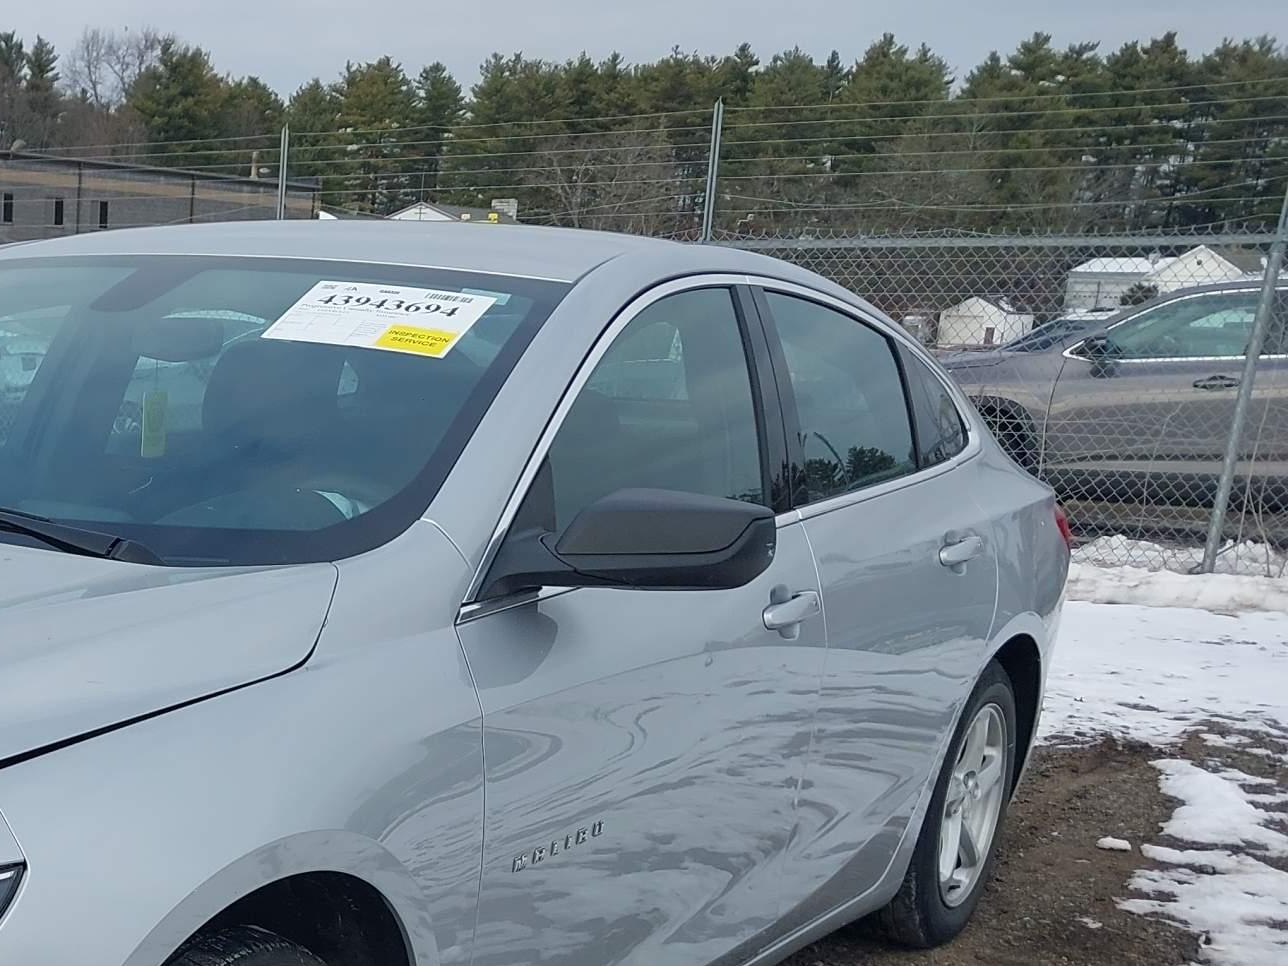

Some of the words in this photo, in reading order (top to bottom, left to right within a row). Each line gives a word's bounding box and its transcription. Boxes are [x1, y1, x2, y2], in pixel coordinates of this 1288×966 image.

[318, 294, 460, 317] 43943694
[388, 330, 450, 343] INSPECTION
[390, 336, 438, 347] SERVICE
[511, 819, 605, 873] MALIBU
